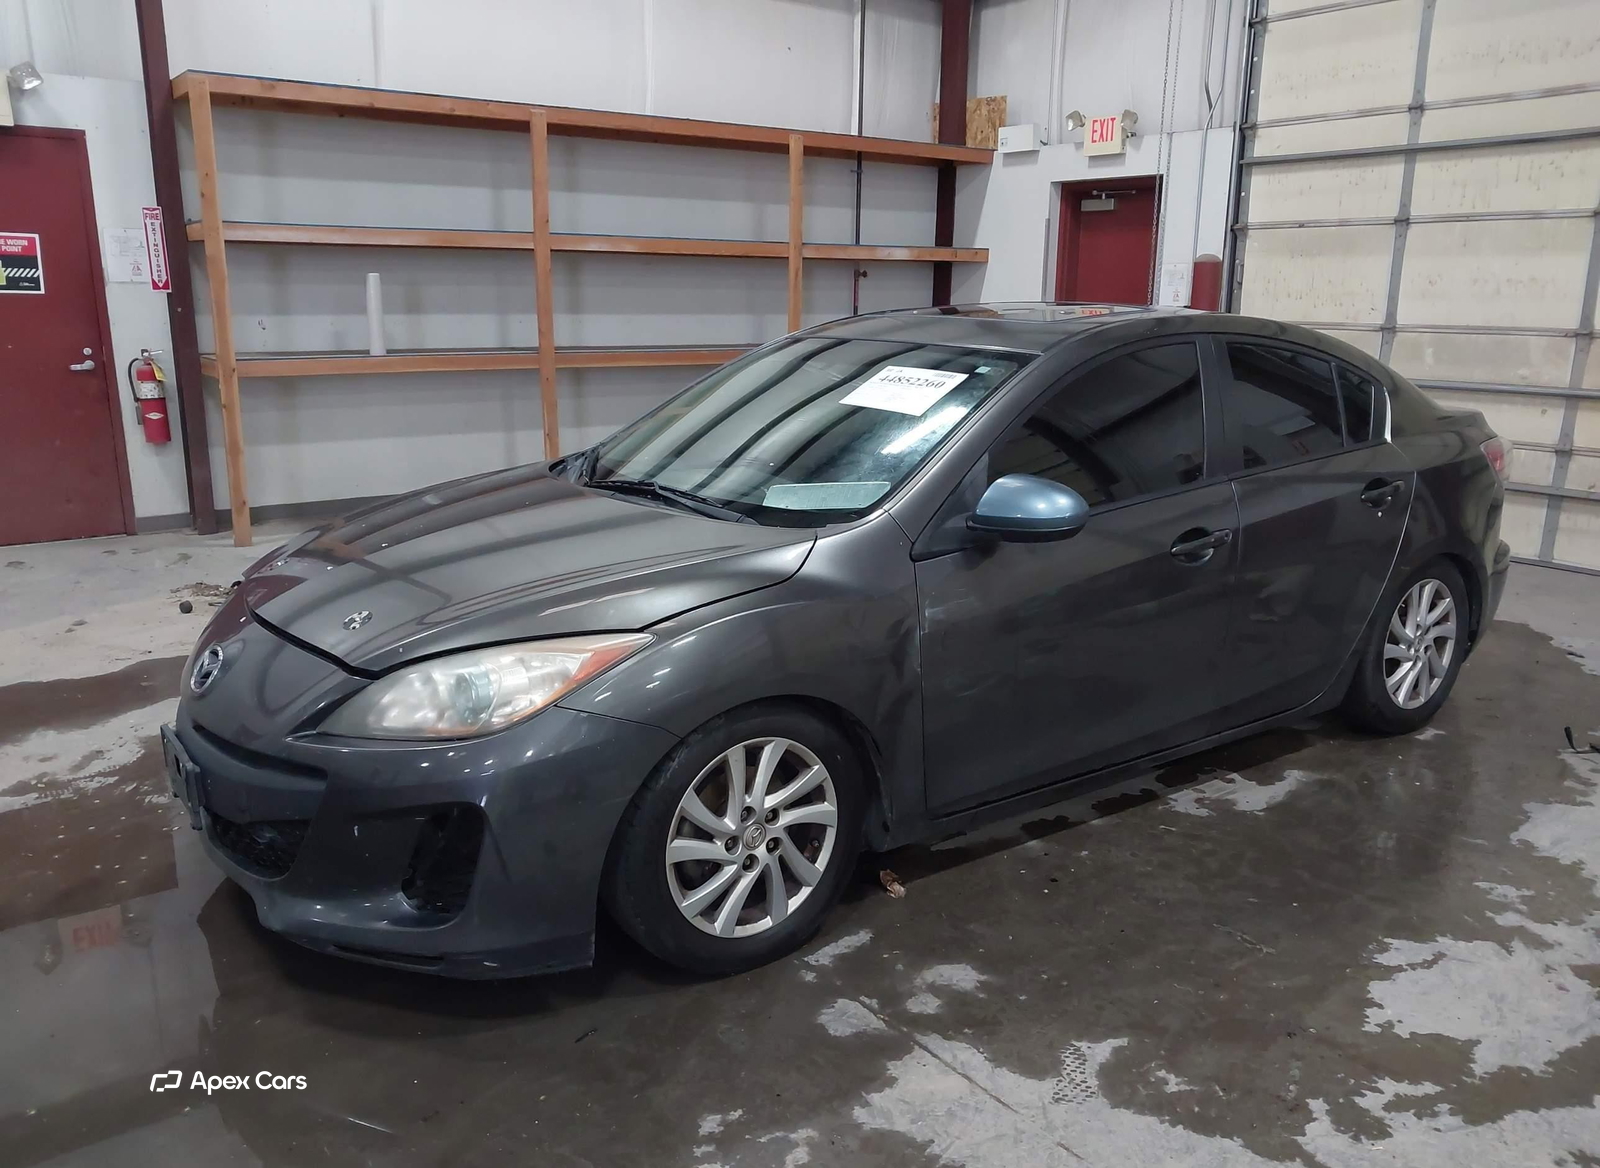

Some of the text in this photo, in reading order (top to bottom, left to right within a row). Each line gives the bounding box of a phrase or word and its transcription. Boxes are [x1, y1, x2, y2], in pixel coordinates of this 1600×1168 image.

[1091, 117, 1116, 143] EXIT
[144, 213, 160, 221] FIRE
[151, 222, 163, 284] EXTINGUISHER
[879, 374, 947, 389] 44852260
